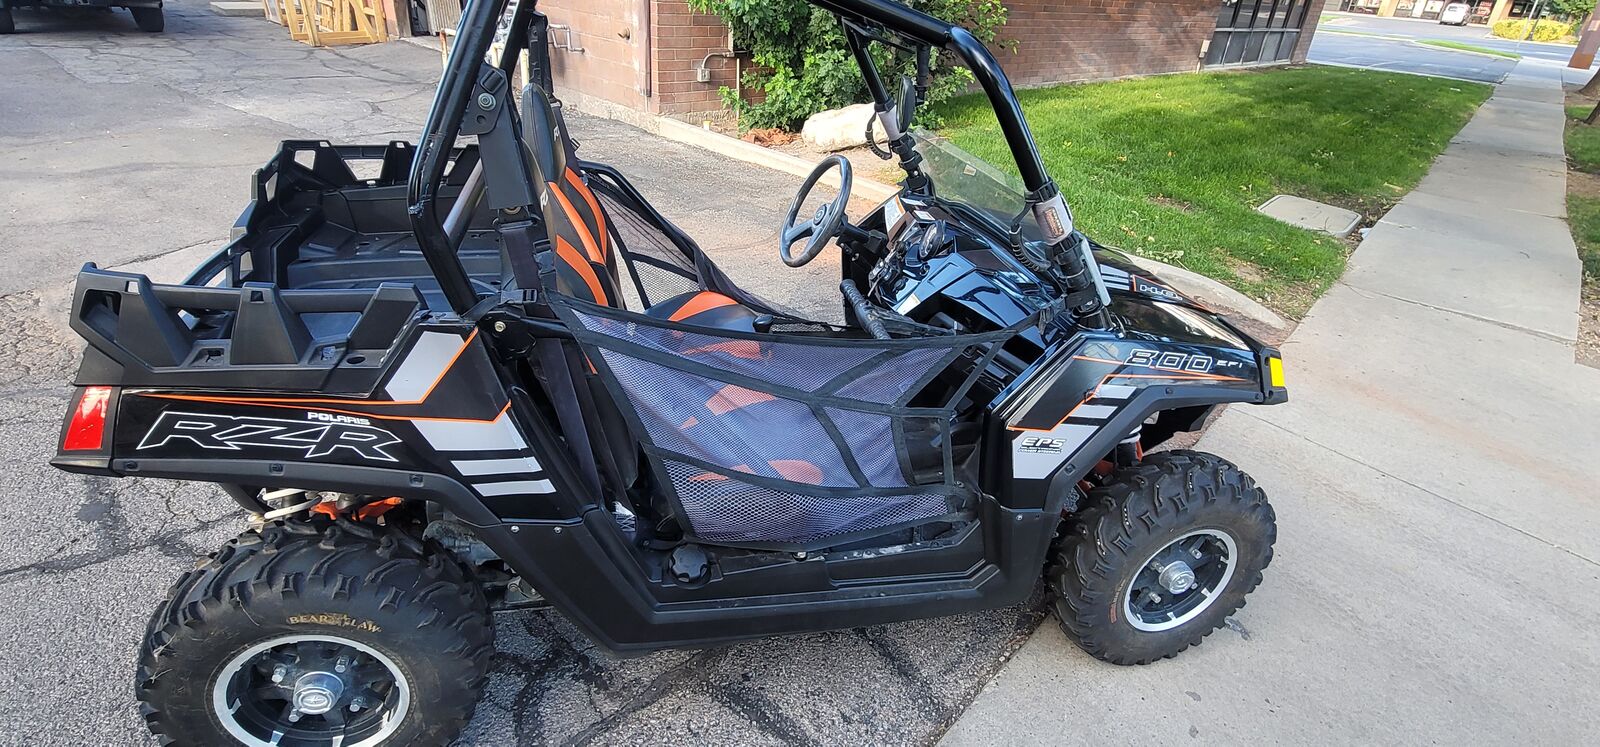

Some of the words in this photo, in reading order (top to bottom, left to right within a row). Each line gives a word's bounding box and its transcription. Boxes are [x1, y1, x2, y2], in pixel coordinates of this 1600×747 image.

[1123, 348, 1213, 373] 800
[1216, 359, 1243, 369] EFI
[307, 411, 371, 426] POLARIS
[136, 410, 402, 462] RZR
[1020, 436, 1067, 448] EPS
[288, 613, 329, 626] BEAR
